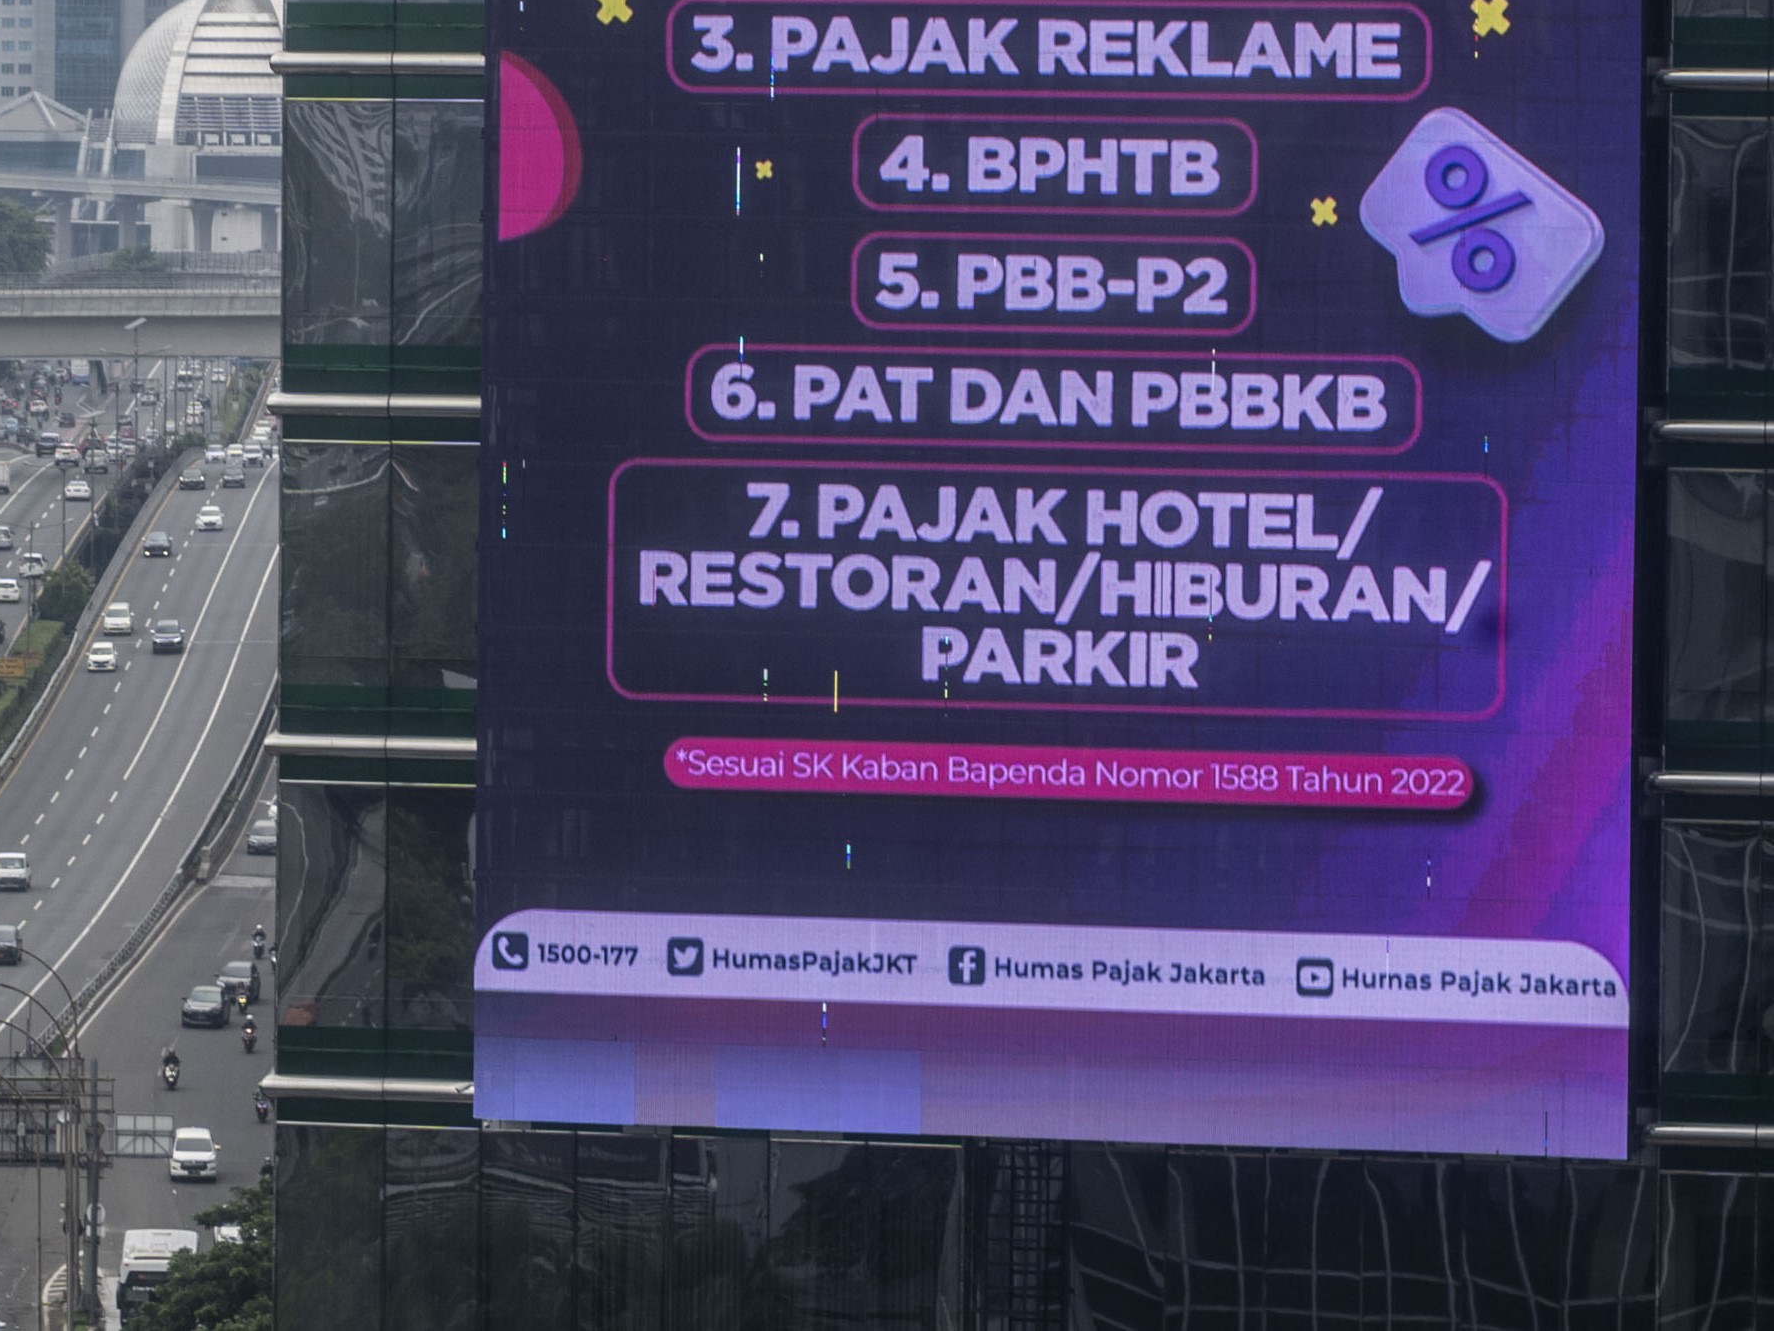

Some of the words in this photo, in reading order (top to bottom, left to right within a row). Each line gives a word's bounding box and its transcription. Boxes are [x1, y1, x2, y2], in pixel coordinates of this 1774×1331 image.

[690, 16, 755, 71] 3.
[770, 16, 1020, 74] PAJAK
[1037, 19, 1402, 78] REKLAME
[878, 135, 951, 191] 4.
[967, 137, 1221, 195] BPHTB
[874, 253, 940, 309] 5.
[956, 254, 1229, 314] PBB-P2
[711, 364, 777, 420] 6.
[793, 366, 935, 422] PAT
[949, 369, 1115, 426] DAN
[1130, 372, 1388, 431] PBBKB
[746, 482, 800, 539] 7.
[817, 483, 1068, 545] PAJAK
[1084, 487, 1384, 560] HOTEL/
[639, 550, 1492, 633] RESTORAN/HIBURAN/
[921, 627, 1200, 688] PARKIR
[792, 753, 833, 778] SK
[841, 754, 939, 781] Kaban
[947, 756, 1086, 790] Bapenda
[1095, 760, 1202, 789] Nomor
[1211, 763, 1279, 791] 1588
[1286, 765, 1383, 794] Tahun
[1391, 768, 1465, 796] 2022
[536, 942, 640, 968] 1500-177
[711, 947, 918, 976] HumasPajakJKT
[995, 955, 1084, 981] Humas
[1092, 960, 1161, 986] Pajak
[1169, 962, 1265, 987] Jakarta
[1441, 970, 1512, 997] Pajak
[1520, 972, 1617, 999] Jakarta
